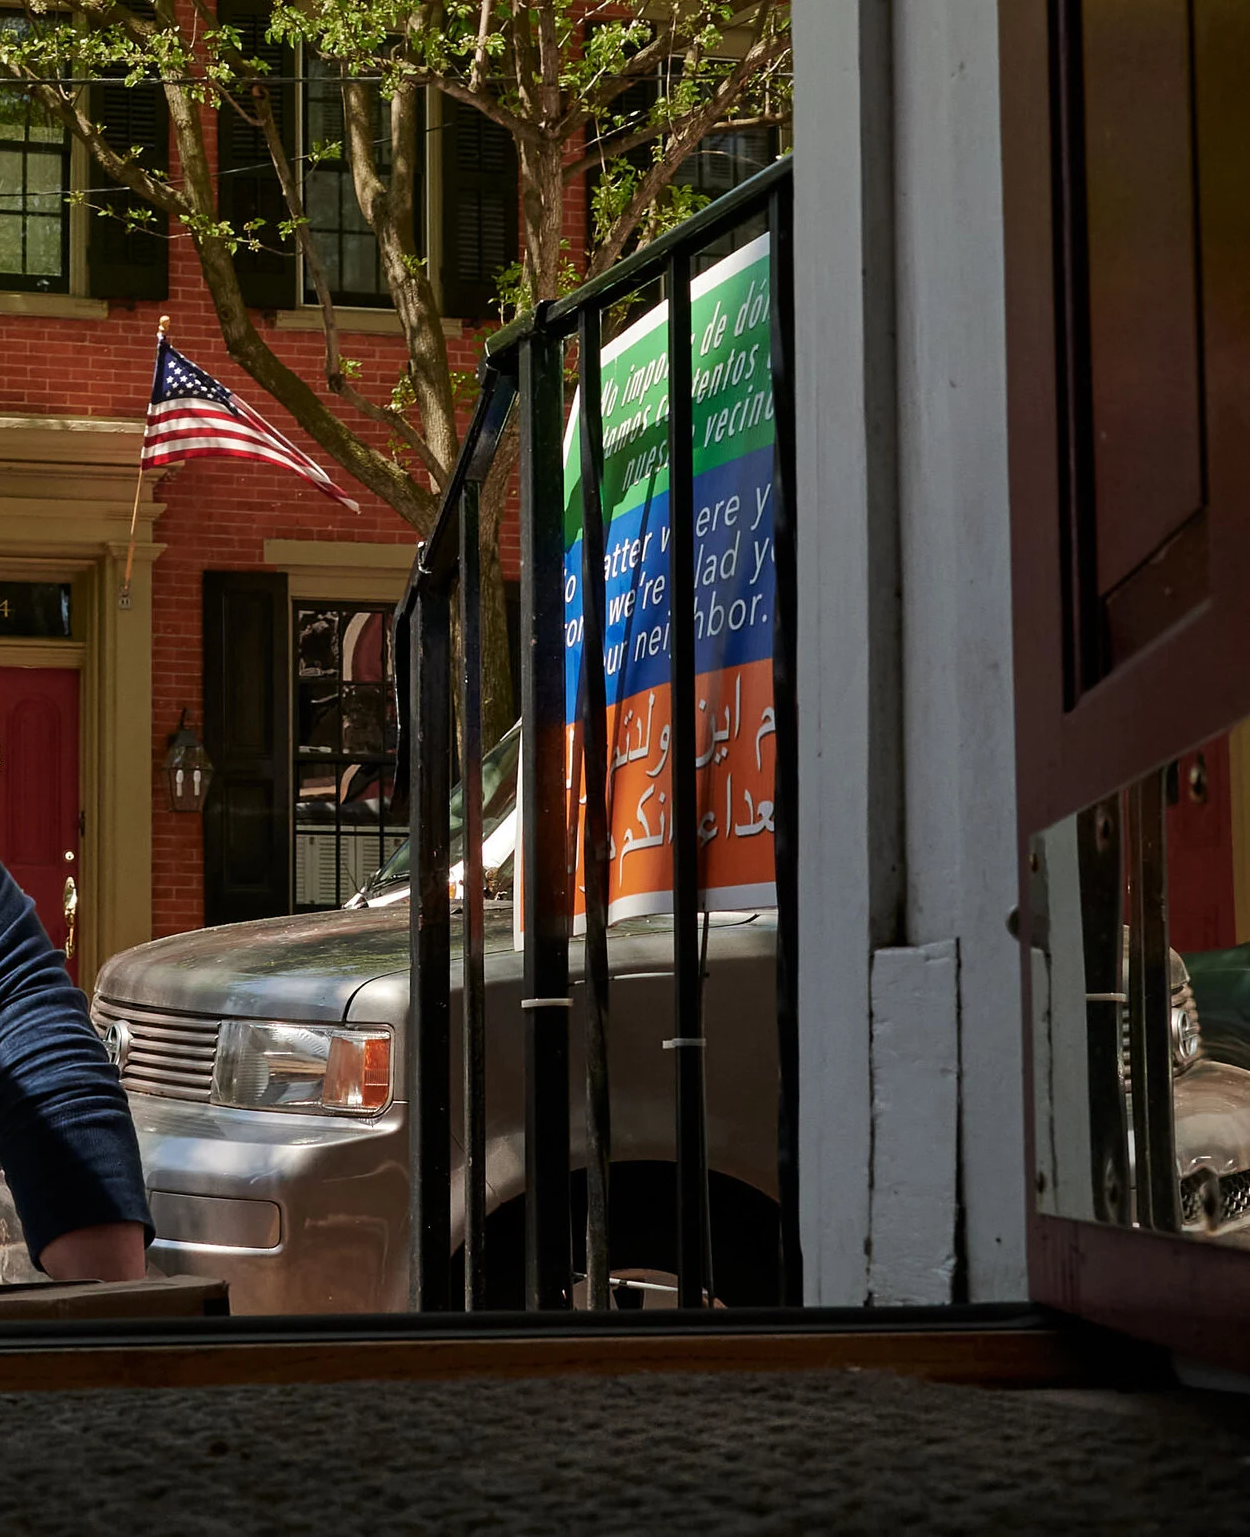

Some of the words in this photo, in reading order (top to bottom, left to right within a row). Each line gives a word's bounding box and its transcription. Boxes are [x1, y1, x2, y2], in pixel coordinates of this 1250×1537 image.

[700, 301, 727, 356] de
[604, 531, 653, 582] atter
[609, 570, 666, 626] we're
[694, 530, 741, 589] lad
[634, 590, 768, 662] neihbor.
